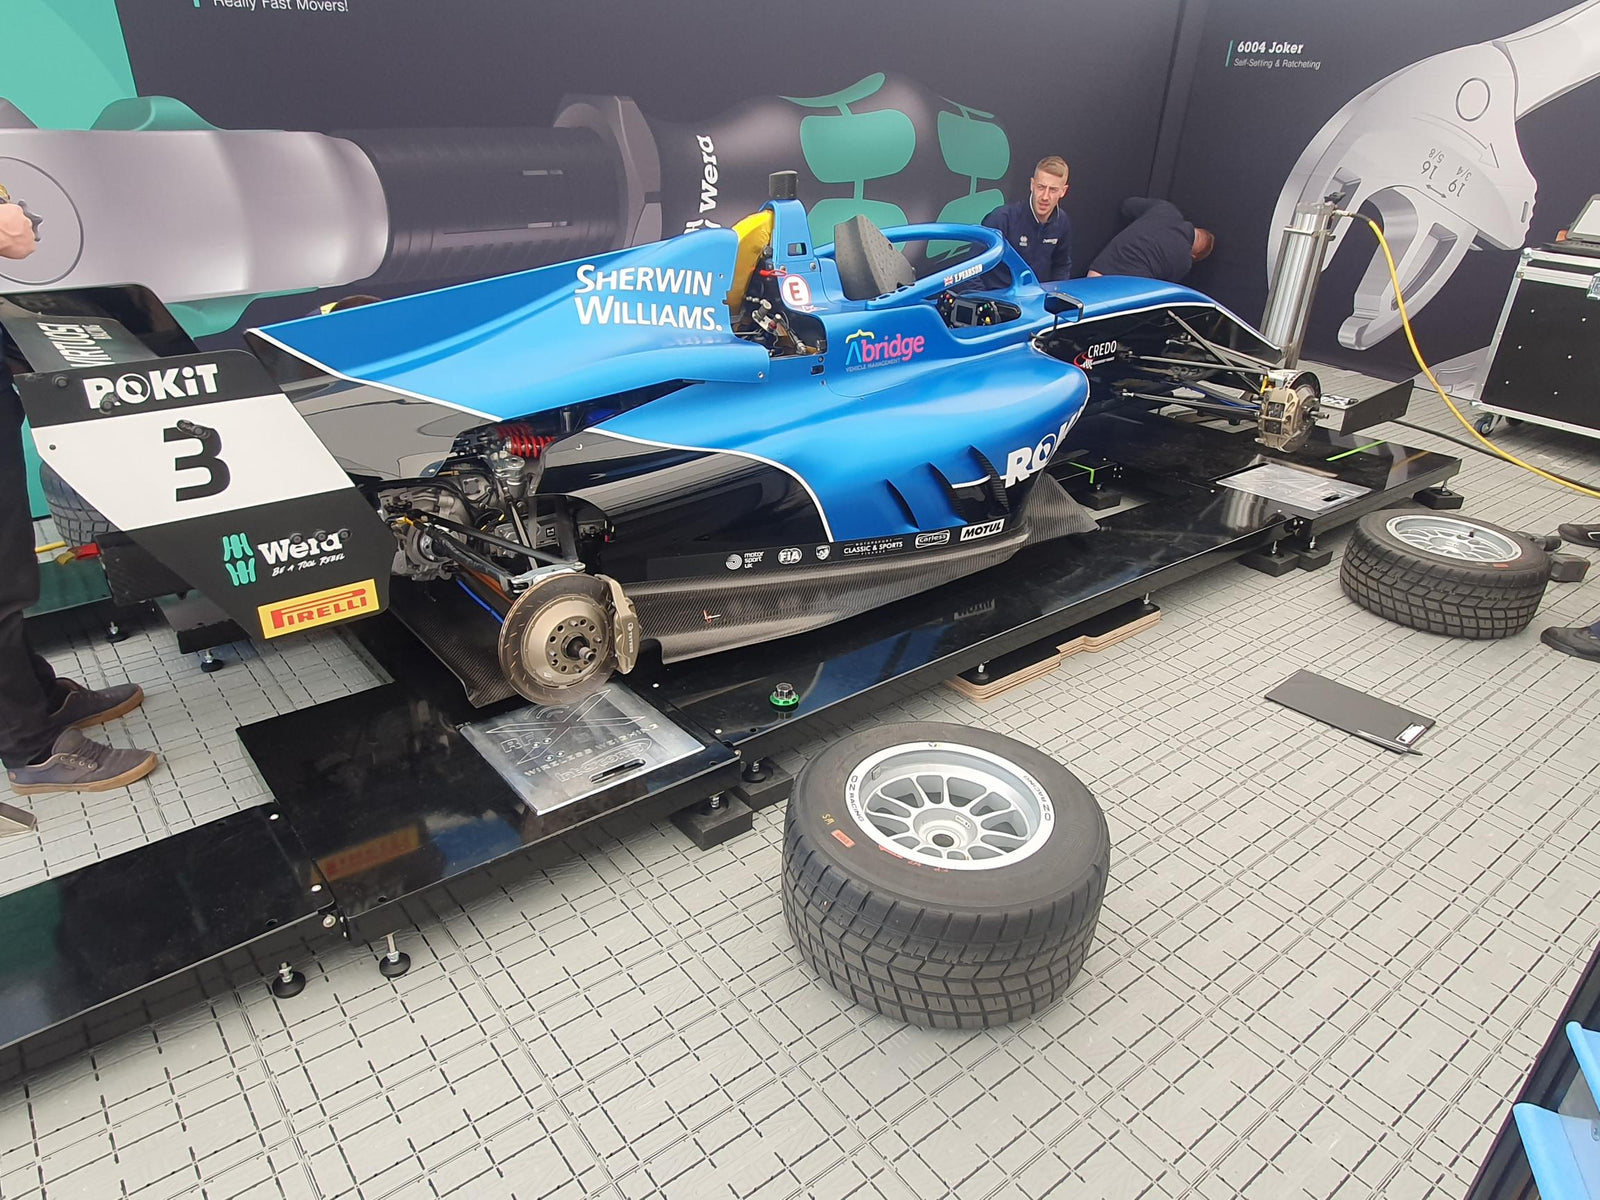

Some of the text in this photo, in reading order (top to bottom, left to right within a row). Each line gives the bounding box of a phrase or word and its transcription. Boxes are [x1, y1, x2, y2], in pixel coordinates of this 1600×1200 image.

[262, 0, 292, 10] Fast
[296, 0, 349, 12] Movers!
[1237, 41, 1304, 54] 6004 Joker
[1233, 58, 1321, 71] Self-Setting & Ratcheting
[696, 135, 719, 213] Wera
[574, 264, 713, 297] SHERWIN
[788, 281, 803, 301] E
[1087, 340, 1117, 359] CREDO
[162, 421, 231, 502] 3
[962, 521, 1003, 540] MOTUL
[780, 551, 800, 562] FIA
[843, 541, 904, 555] CLASSIC & SPORTS
[271, 553, 346, 577] BE A TOOL REBEL
[271, 589, 368, 629] PIRELLI
[848, 792, 865, 822] RACING
